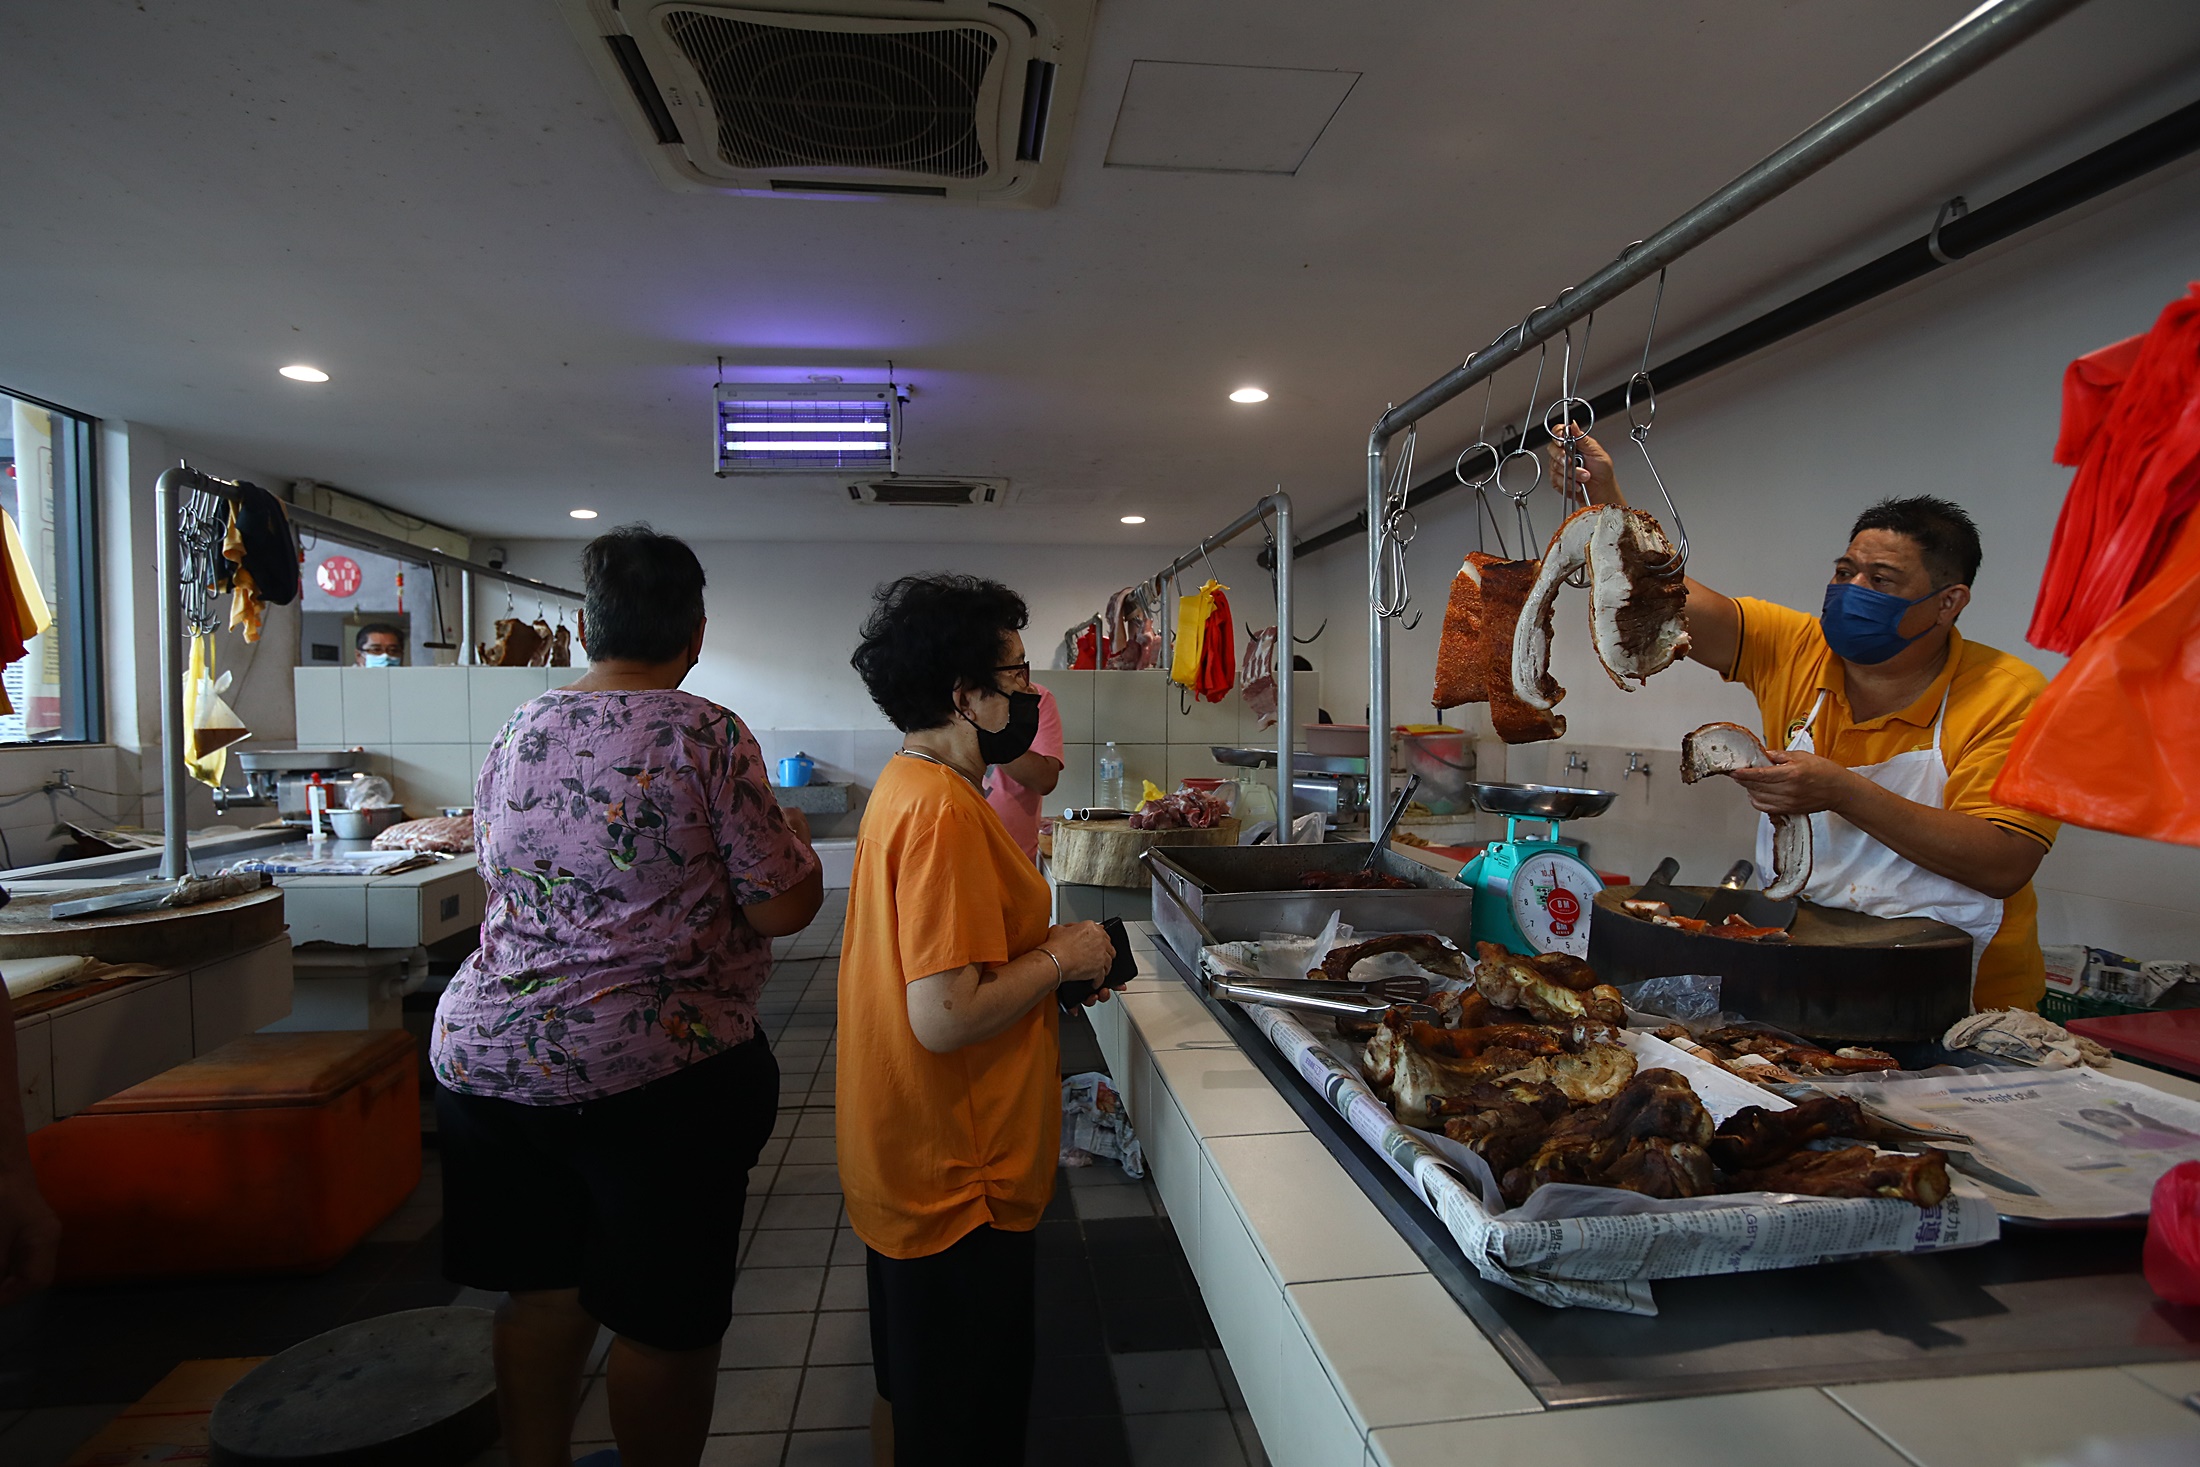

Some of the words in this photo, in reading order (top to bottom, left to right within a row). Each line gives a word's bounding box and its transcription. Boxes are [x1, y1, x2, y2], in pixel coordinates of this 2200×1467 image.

[1529, 879, 1534, 887] 9
[1583, 892, 1588, 900] 2
[1523, 898, 1529, 906] 8
[1530, 920, 1534, 928] 7
[1962, 1096, 1989, 1105] The
[1987, 1093, 2016, 1104] right
